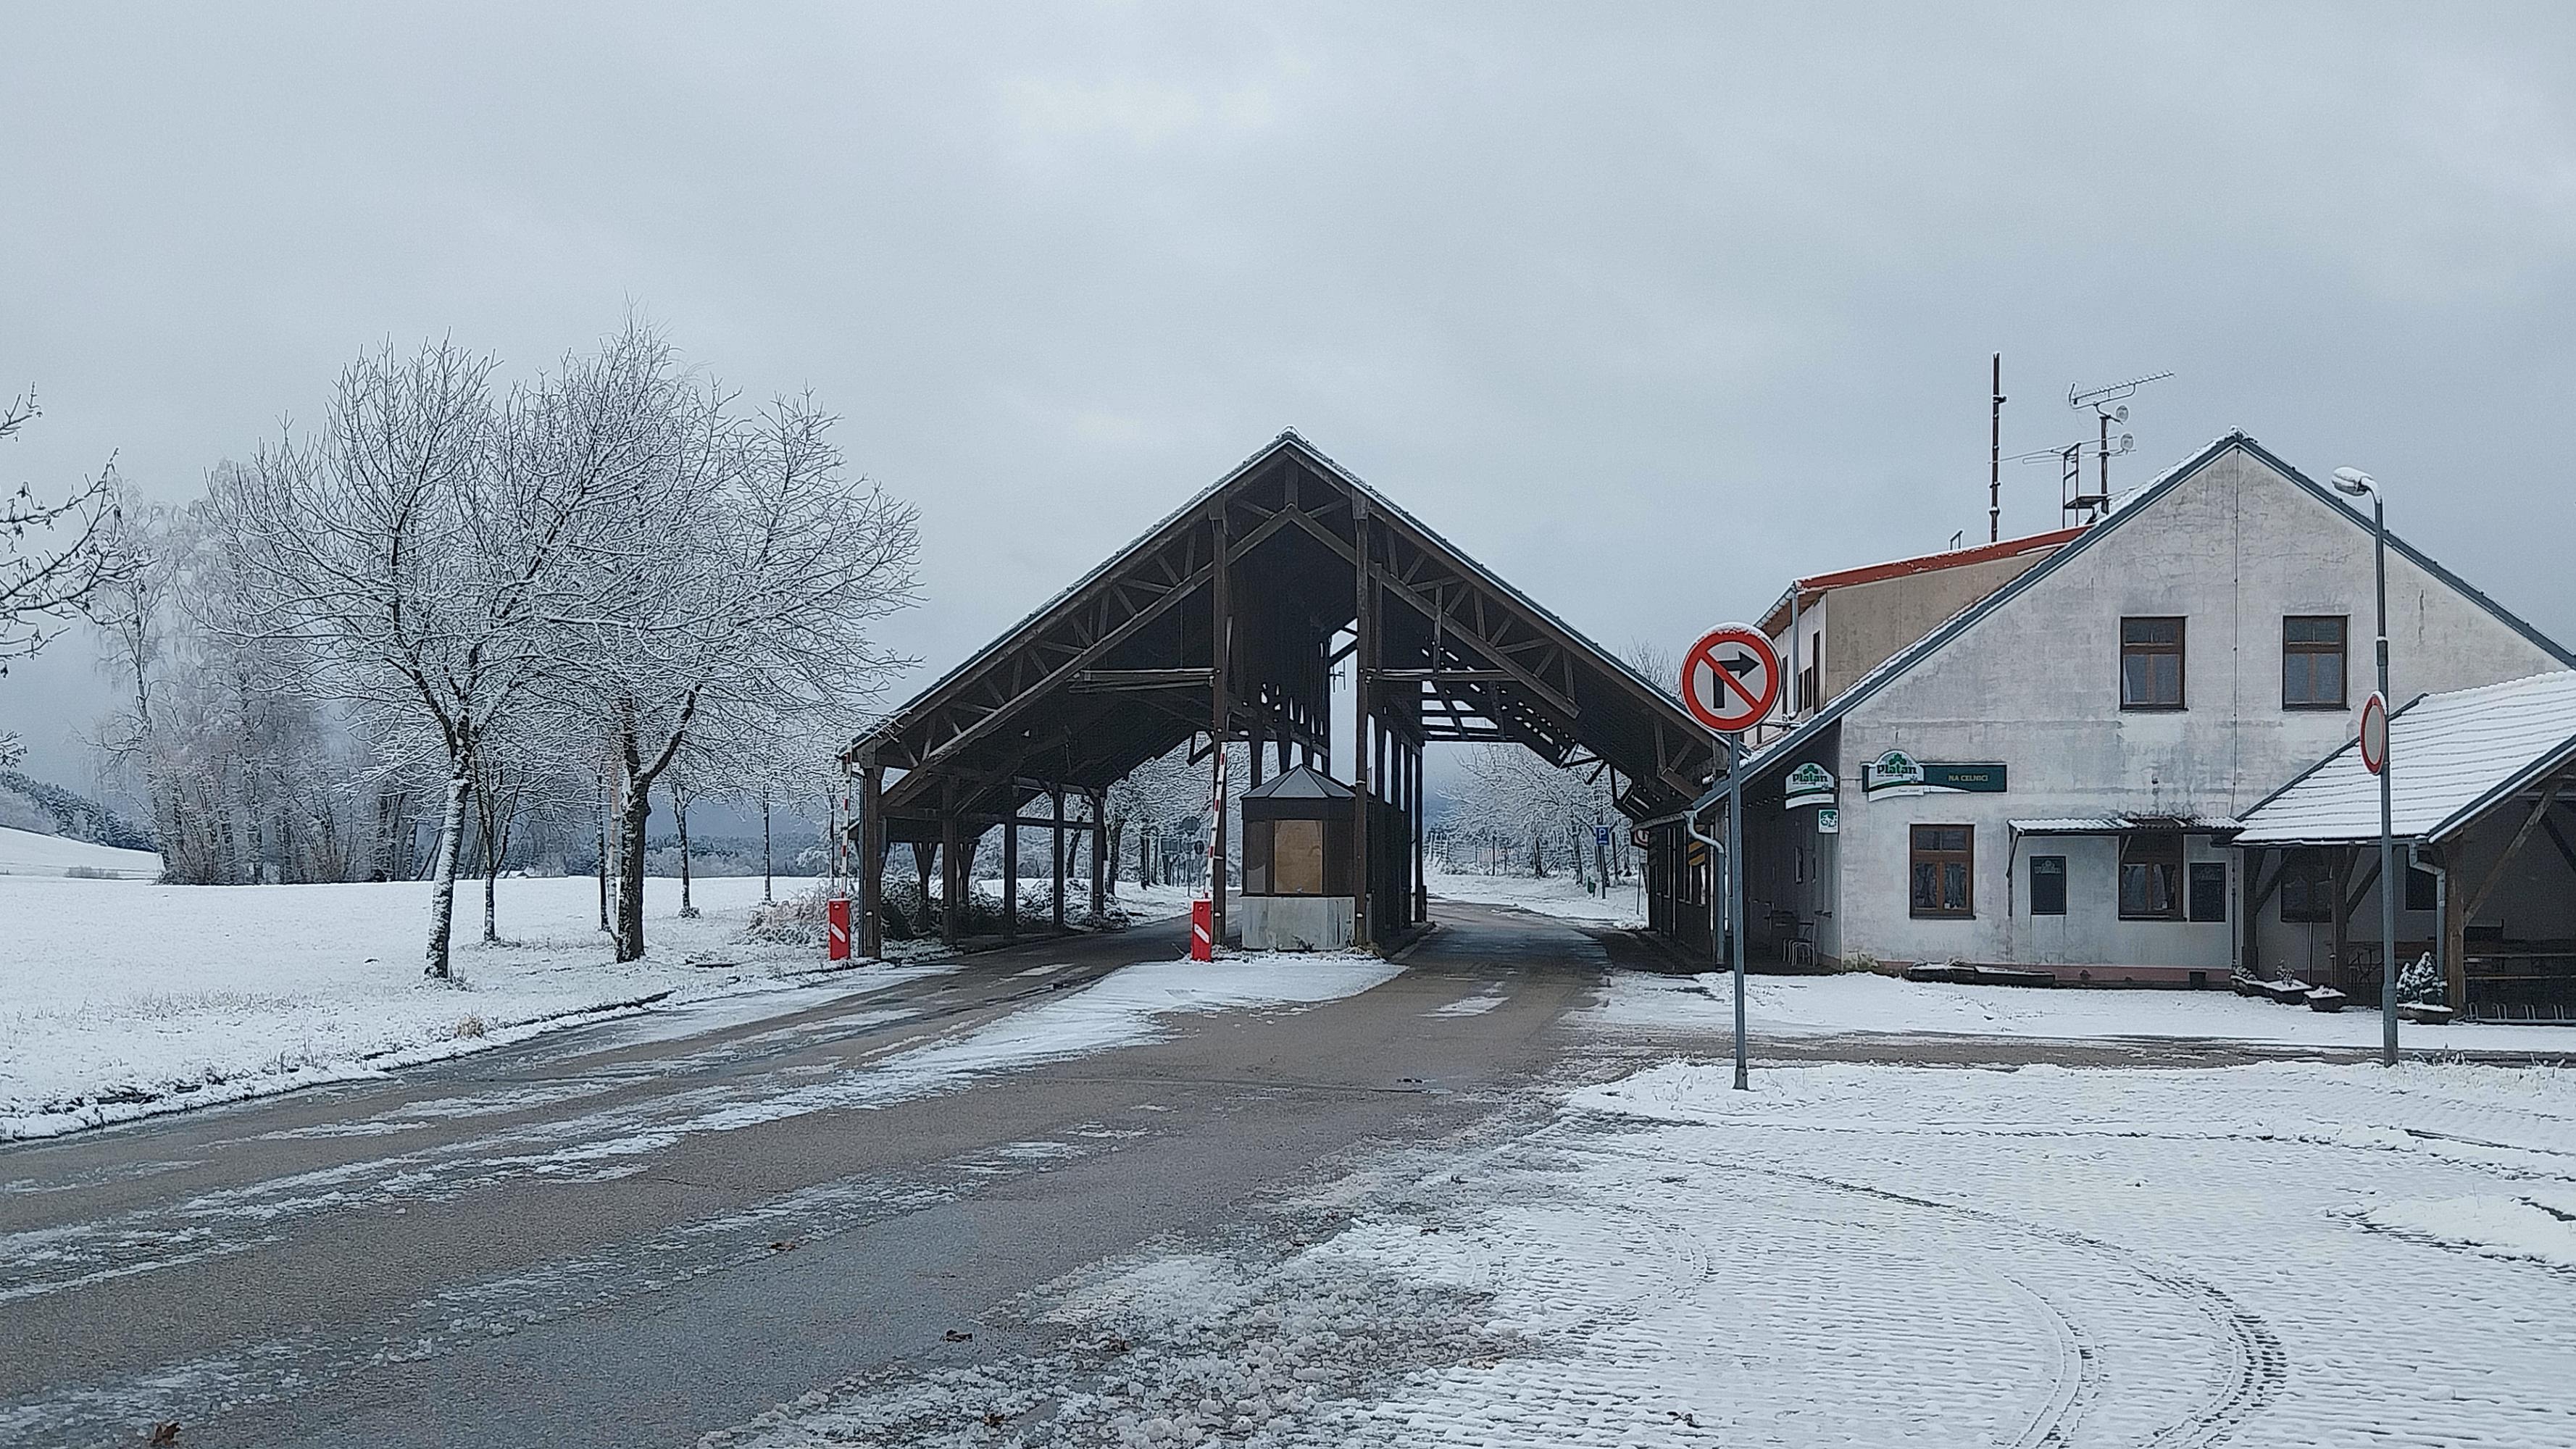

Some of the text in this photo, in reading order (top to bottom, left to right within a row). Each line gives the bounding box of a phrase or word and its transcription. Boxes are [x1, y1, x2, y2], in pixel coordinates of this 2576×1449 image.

[1877, 764, 1917, 774] Platan
[1792, 773, 1828, 782] Platan
[1598, 828, 1606, 839] P
